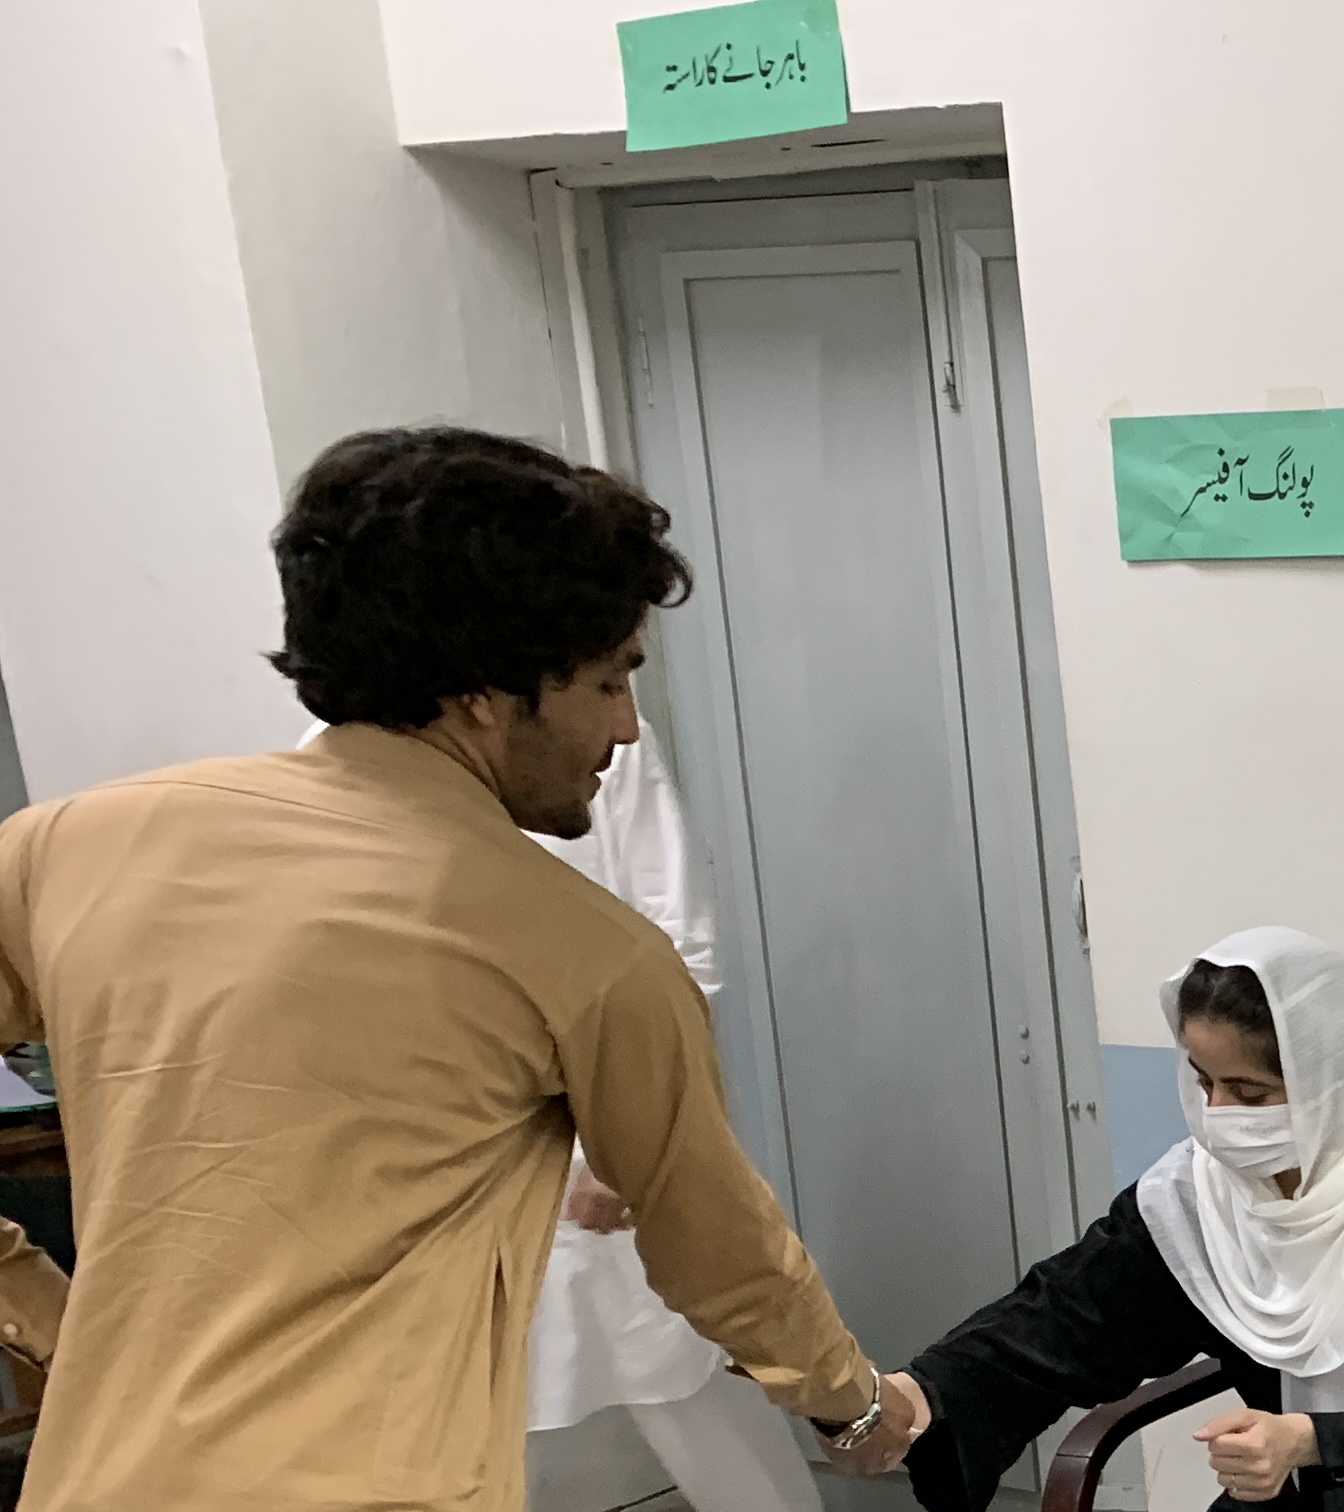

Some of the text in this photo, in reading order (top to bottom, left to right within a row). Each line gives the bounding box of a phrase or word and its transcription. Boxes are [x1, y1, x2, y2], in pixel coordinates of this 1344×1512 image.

[663, 38, 808, 94] باہر جانے کا راستہ
[1179, 444, 1315, 519] پولنگ آفیسر
